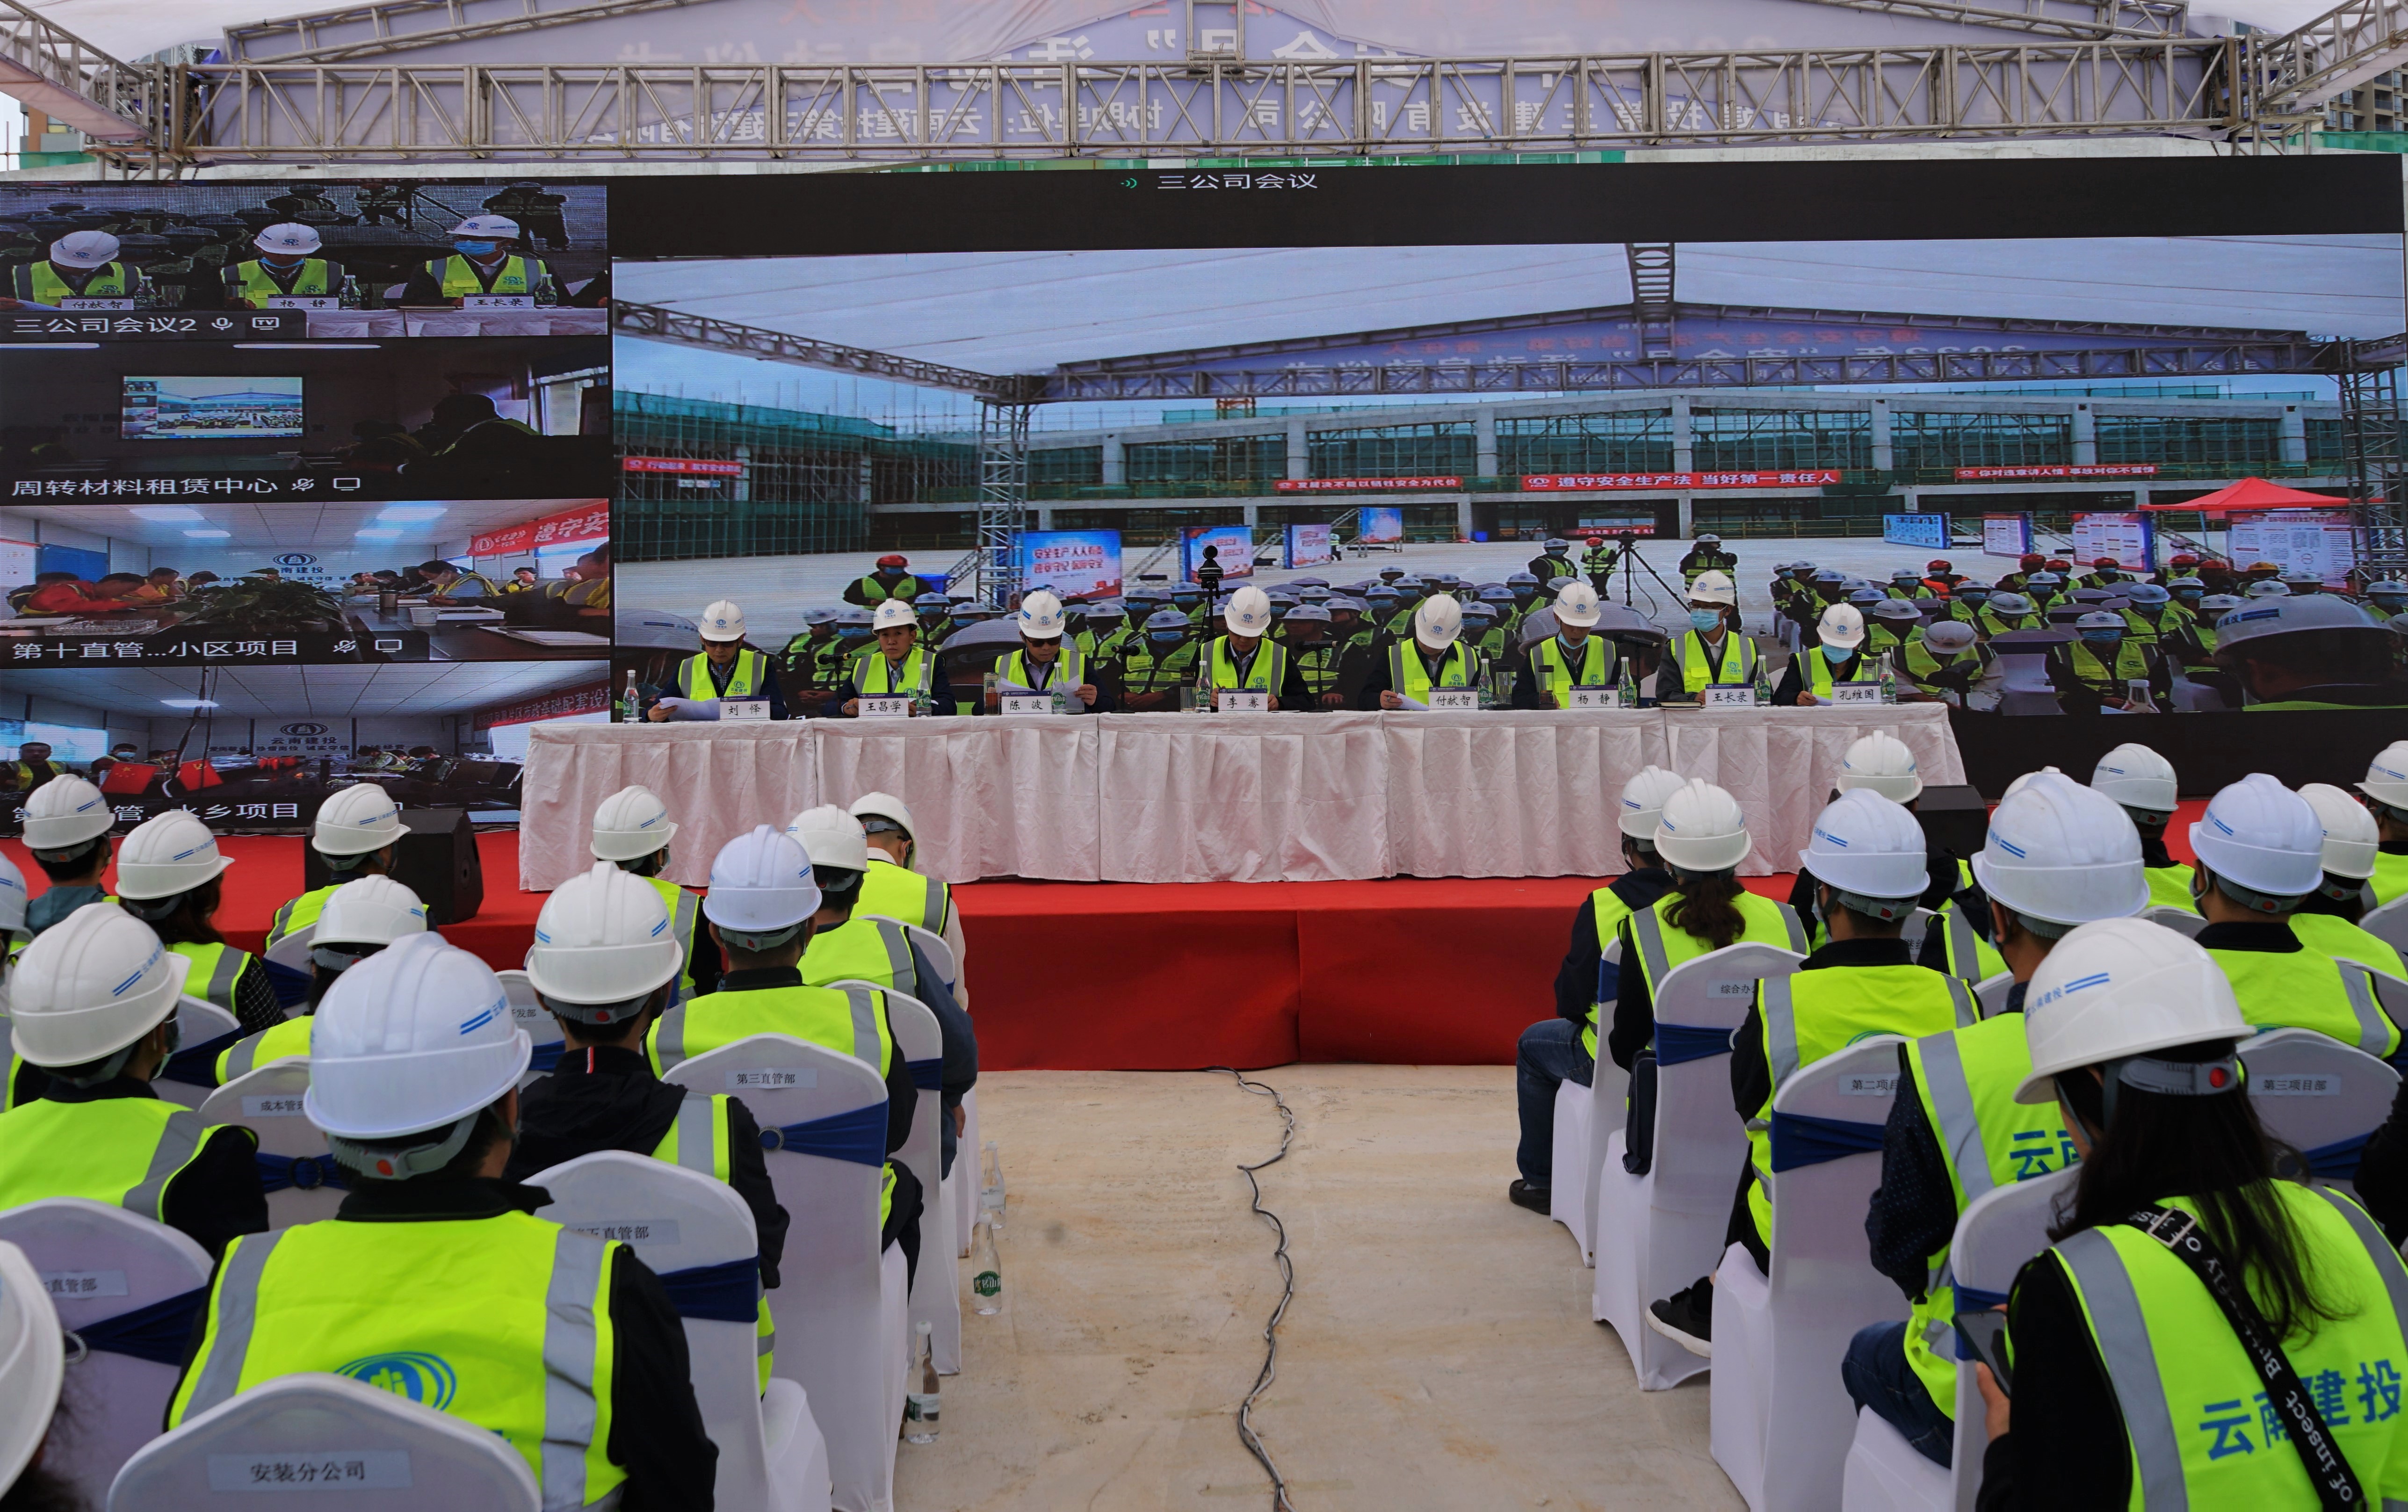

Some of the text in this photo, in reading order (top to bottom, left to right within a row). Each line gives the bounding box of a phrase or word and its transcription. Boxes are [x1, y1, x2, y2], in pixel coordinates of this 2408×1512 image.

[1157, 174, 1317, 190] 三公司会议
[13, 317, 197, 333] 三公司会议2
[1557, 471, 1837, 487] 遵守安全生产法 当好第一责任人
[12, 477, 279, 496] 周转材料租赁中心
[1436, 695, 1471, 706] 付献智
[1577, 693, 1611, 705] 杨静
[1713, 691, 1748, 703] 王长录
[1839, 689, 1874, 701] 孔维国
[865, 701, 901, 713] 王昌学
[1010, 699, 1043, 710] 陈波
[1721, 984, 1754, 994] 综合办
[736, 1072, 796, 1085] 第三直管部
[2262, 1078, 2327, 1092] 第三项目部
[575, 1226, 649, 1241] 五直管部
[2285, 1390, 2338, 1473] insect
[250, 1461, 366, 1483] 安装分公司
